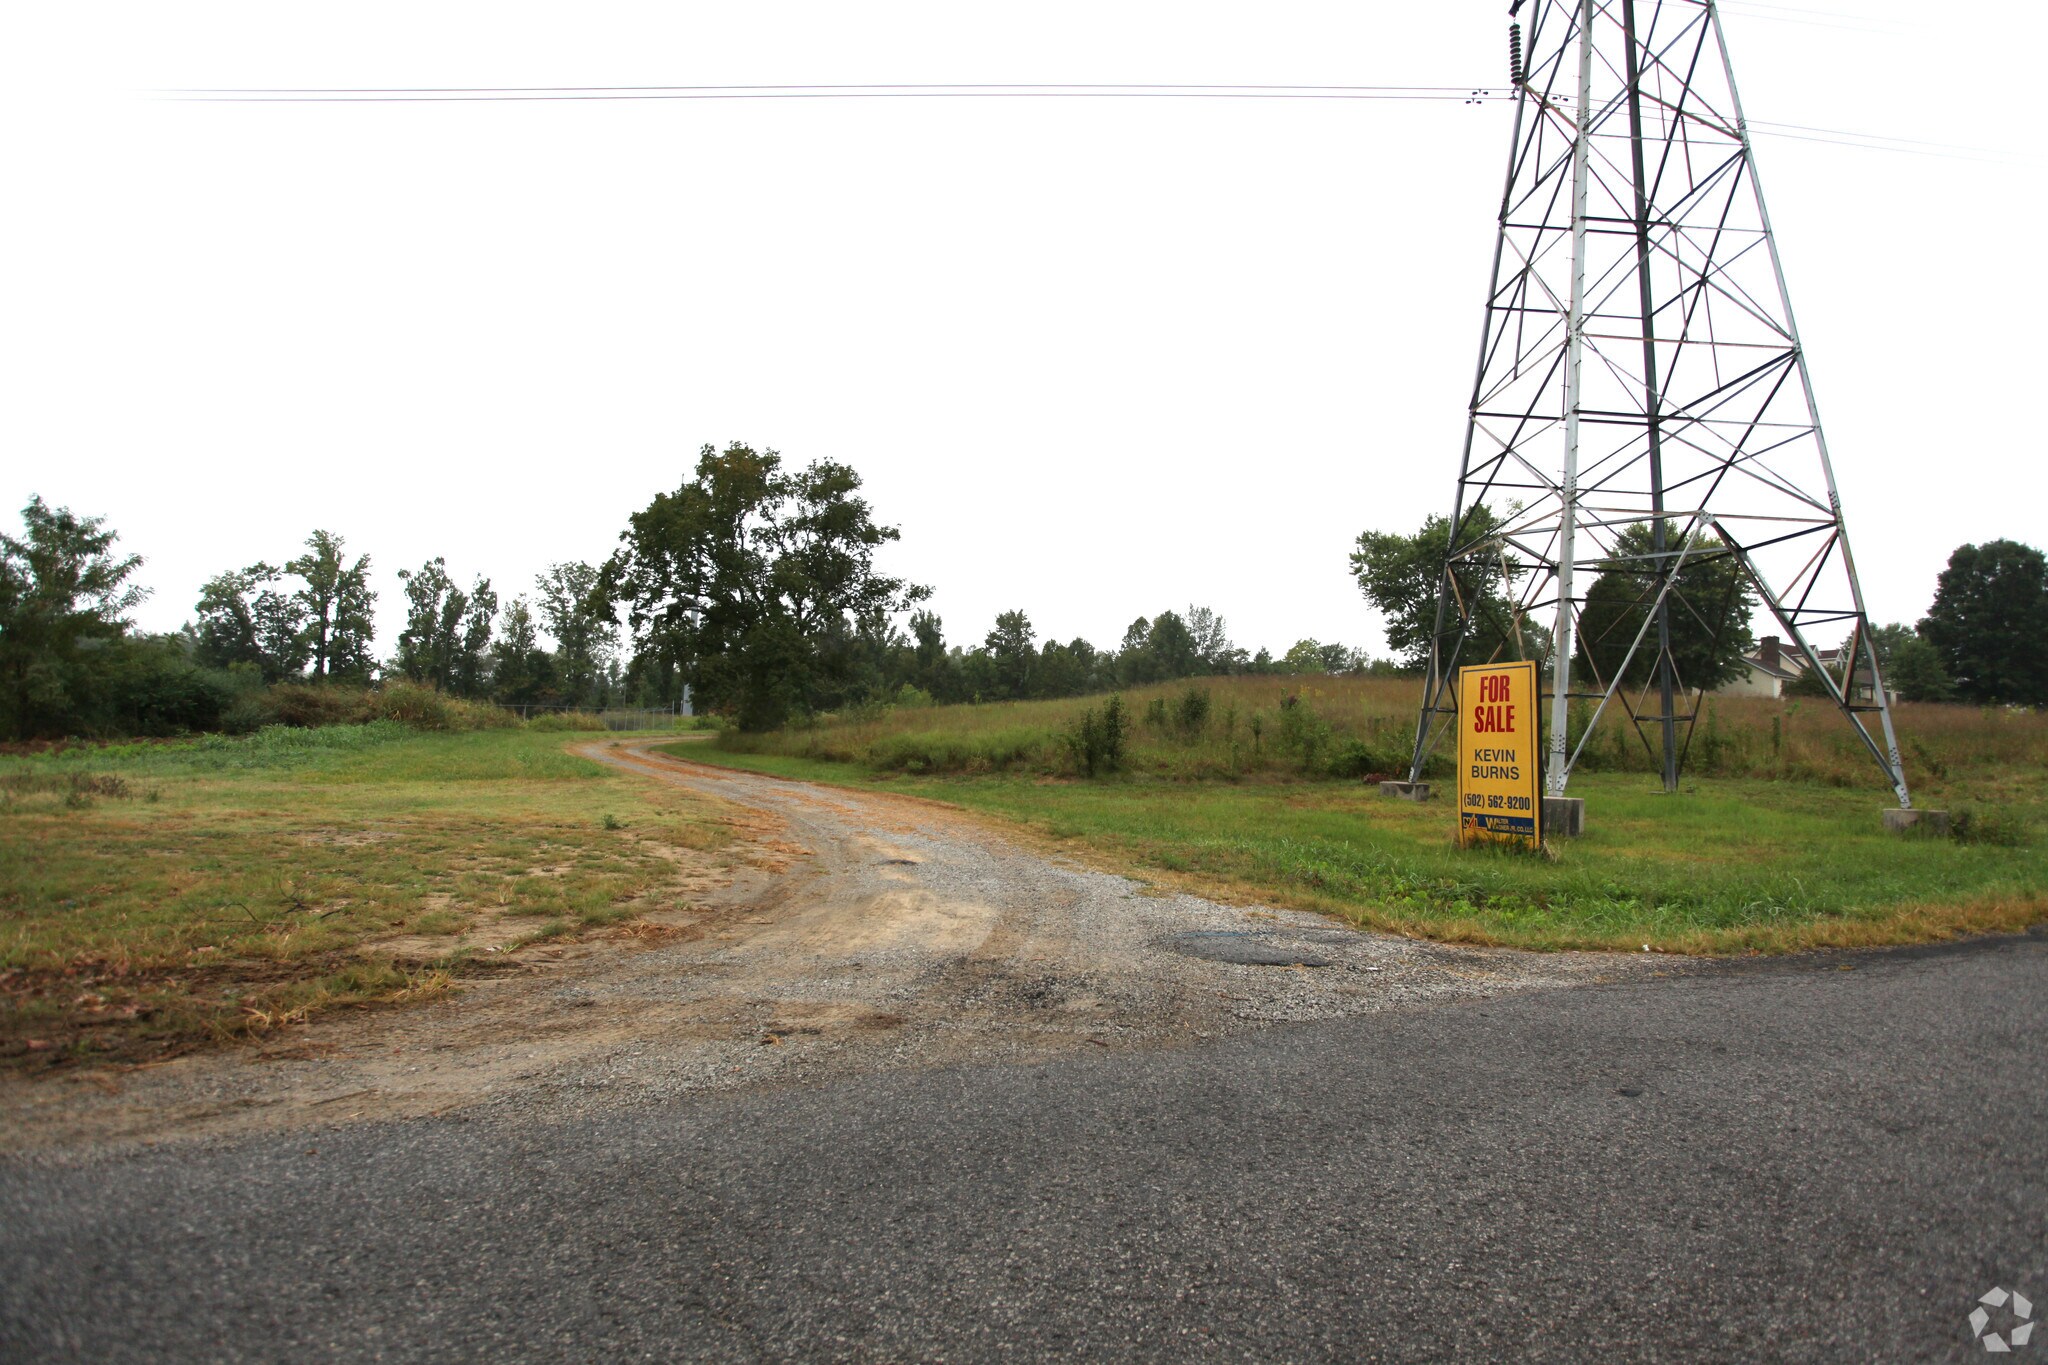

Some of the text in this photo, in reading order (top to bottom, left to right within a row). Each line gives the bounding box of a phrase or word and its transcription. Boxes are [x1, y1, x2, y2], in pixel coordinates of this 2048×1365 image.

[1480, 675, 1510, 703] FOR
[1474, 705, 1515, 733] SALE
[1475, 749, 1515, 763] KEVIN
[1472, 766, 1519, 780] BURNS
[1464, 793, 1530, 811] (502) 562-9200
